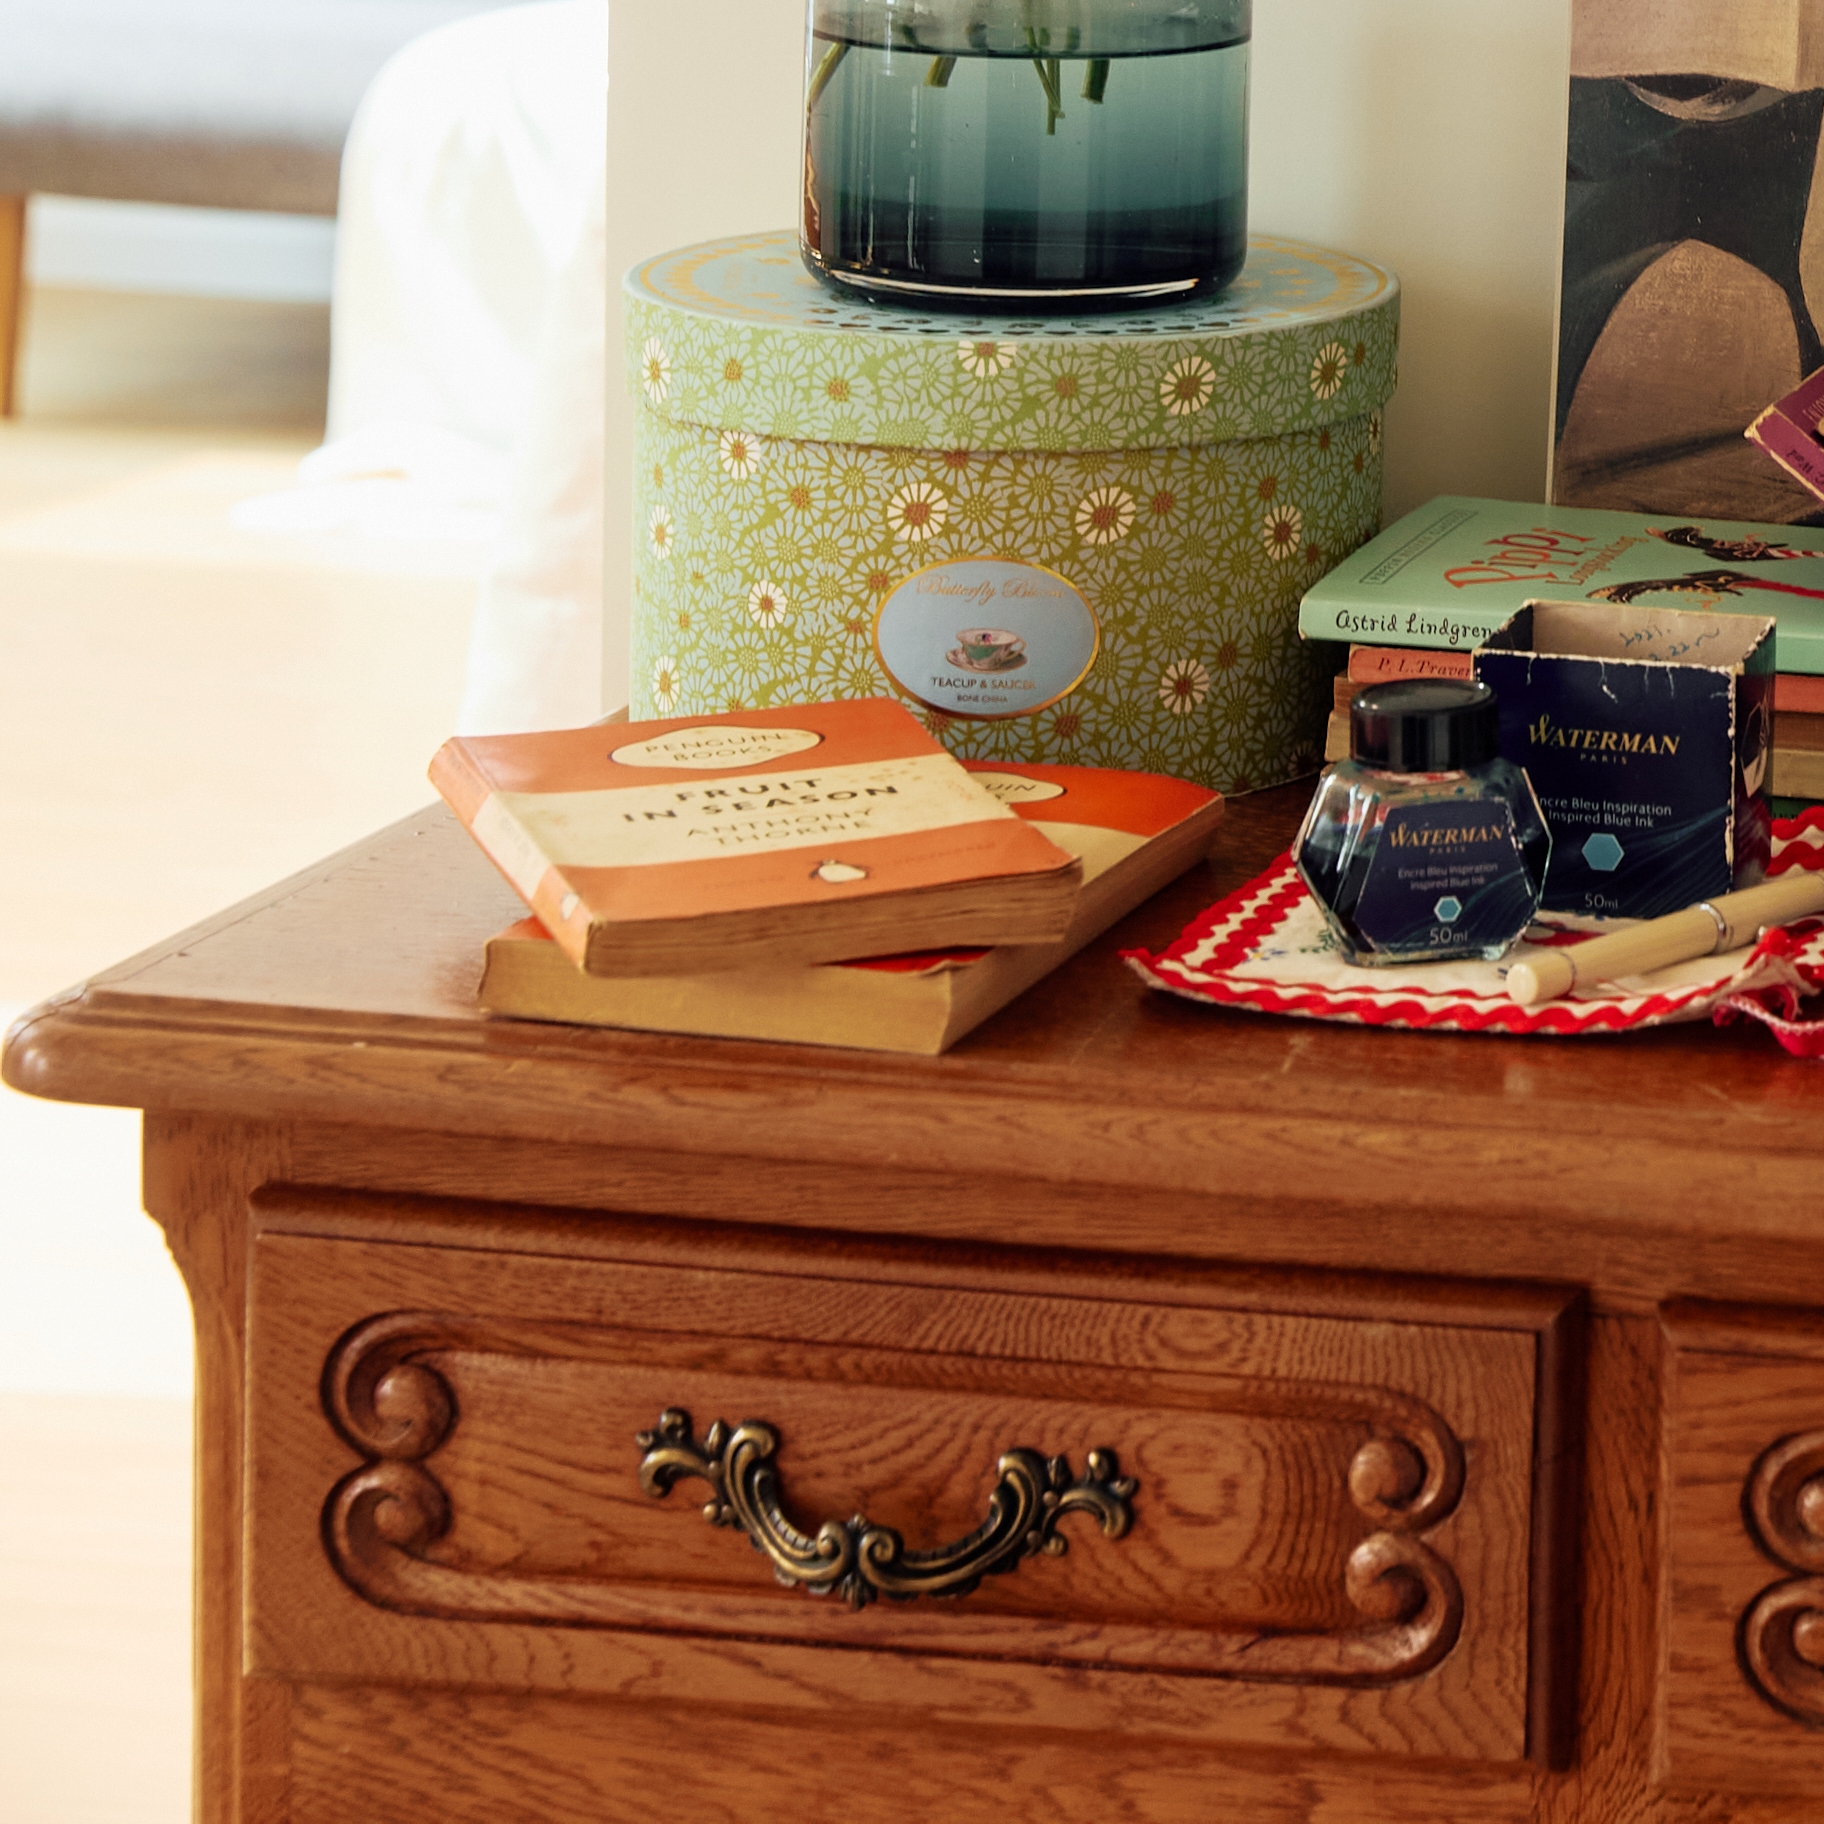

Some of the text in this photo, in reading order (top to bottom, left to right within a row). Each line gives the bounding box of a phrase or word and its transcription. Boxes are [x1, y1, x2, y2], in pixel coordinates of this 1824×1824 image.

[1444, 527, 1597, 589] Pippi
[916, 574, 995, 606] Butterfly
[1335, 609, 1493, 645] Astrid Lindgren
[1377, 657, 1394, 672] P.
[1398, 659, 1414, 674] L.
[932, 677, 1037, 690] TEACUP & SAUCER
[957, 694, 1008, 703] BONE CHINA
[645, 731, 790, 754] PENGUIN
[1529, 714, 1681, 756] WATERMAN
[674, 745, 775, 764] BOOKS
[1580, 753, 1628, 766] PARIS
[675, 777, 824, 805] FRUIT
[623, 784, 902, 824] IN SEASON
[1539, 796, 1672, 822] ncre Bleu Inspiration
[686, 807, 876, 839] ANTHONY
[1548, 809, 1654, 829] Inspired Blue Ink
[715, 820, 875, 847] THORNE
[1390, 822, 1505, 848] WATERMAN
[1429, 845, 1466, 855] PARIS
[1398, 862, 1499, 880] Encre Bleu Inspiration
[1450, 876, 1471, 888] Blue
[1584, 893, 1619, 909] 50ml
[1429, 926, 1469, 946] 50ml
